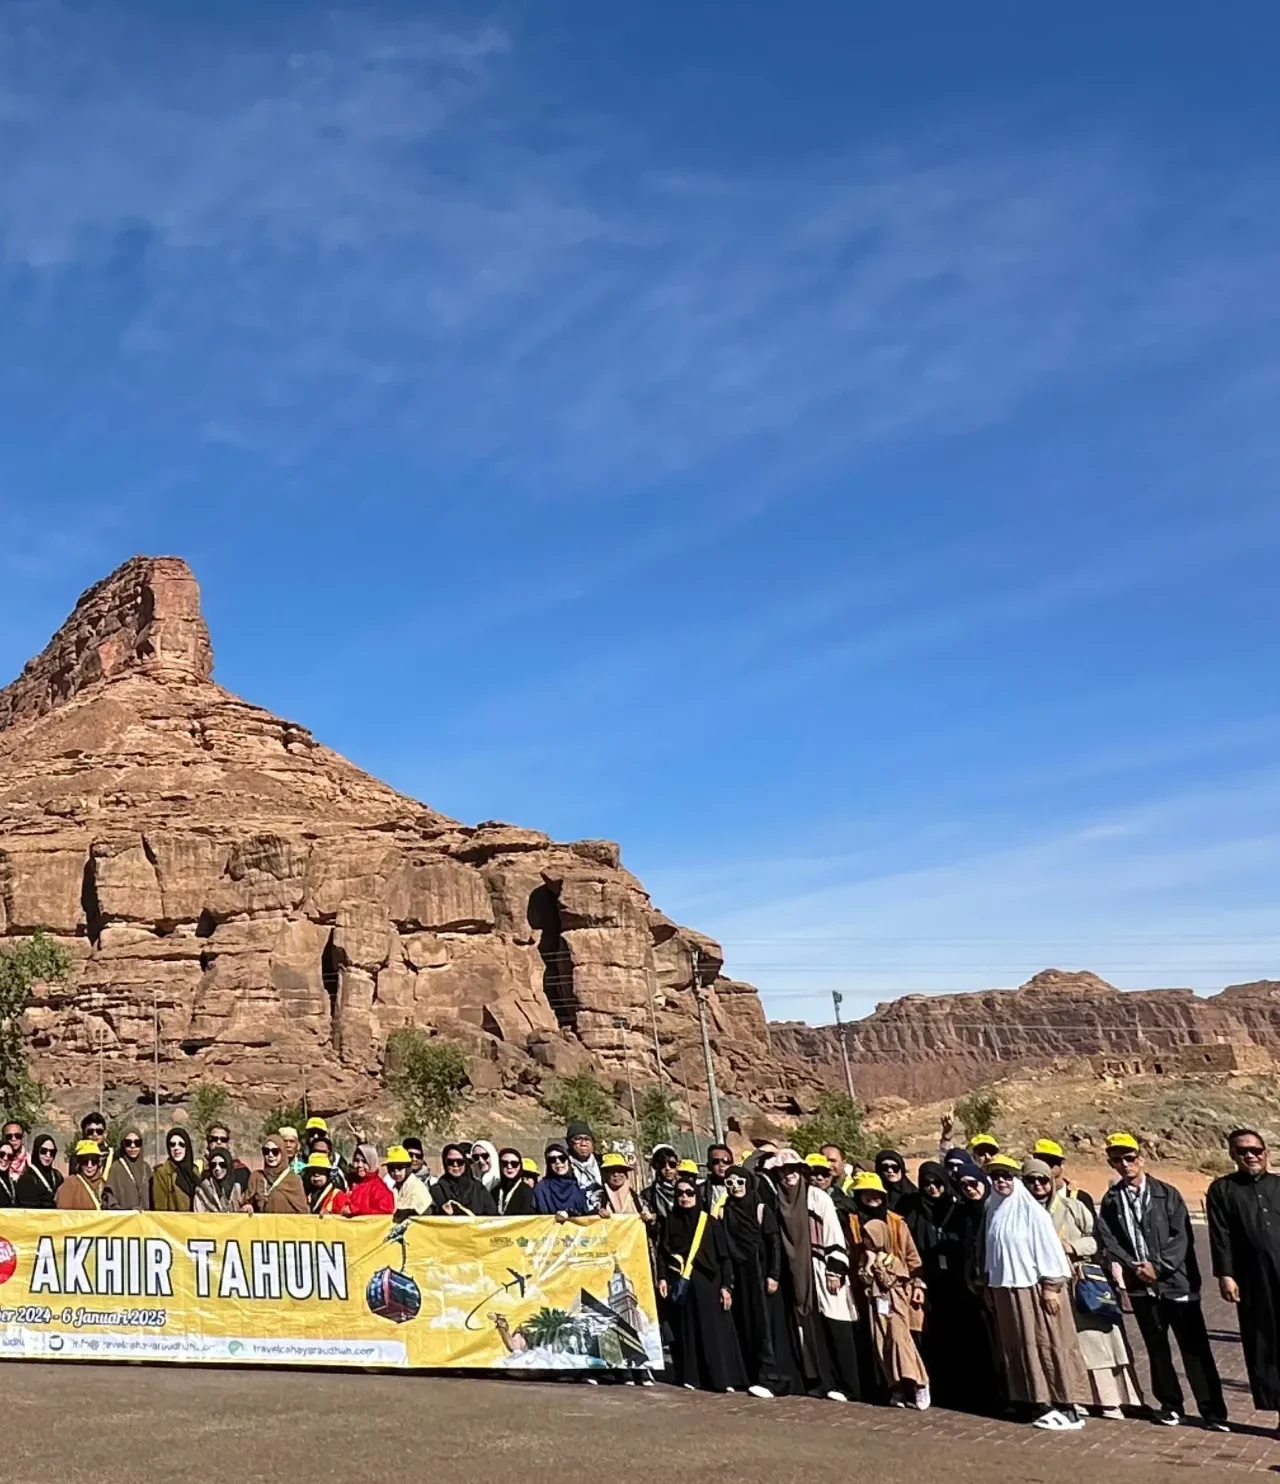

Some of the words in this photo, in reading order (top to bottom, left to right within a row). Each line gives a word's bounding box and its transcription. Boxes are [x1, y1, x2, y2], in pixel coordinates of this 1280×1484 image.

[29, 1236, 173, 1297] AKHIR
[187, 1238, 349, 1300] TAHUN
[16, 1306, 52, 1324] 2024
[61, 1307, 73, 1325] 6
[73, 1307, 129, 1328] Januari
[128, 1309, 166, 1327] 2025
